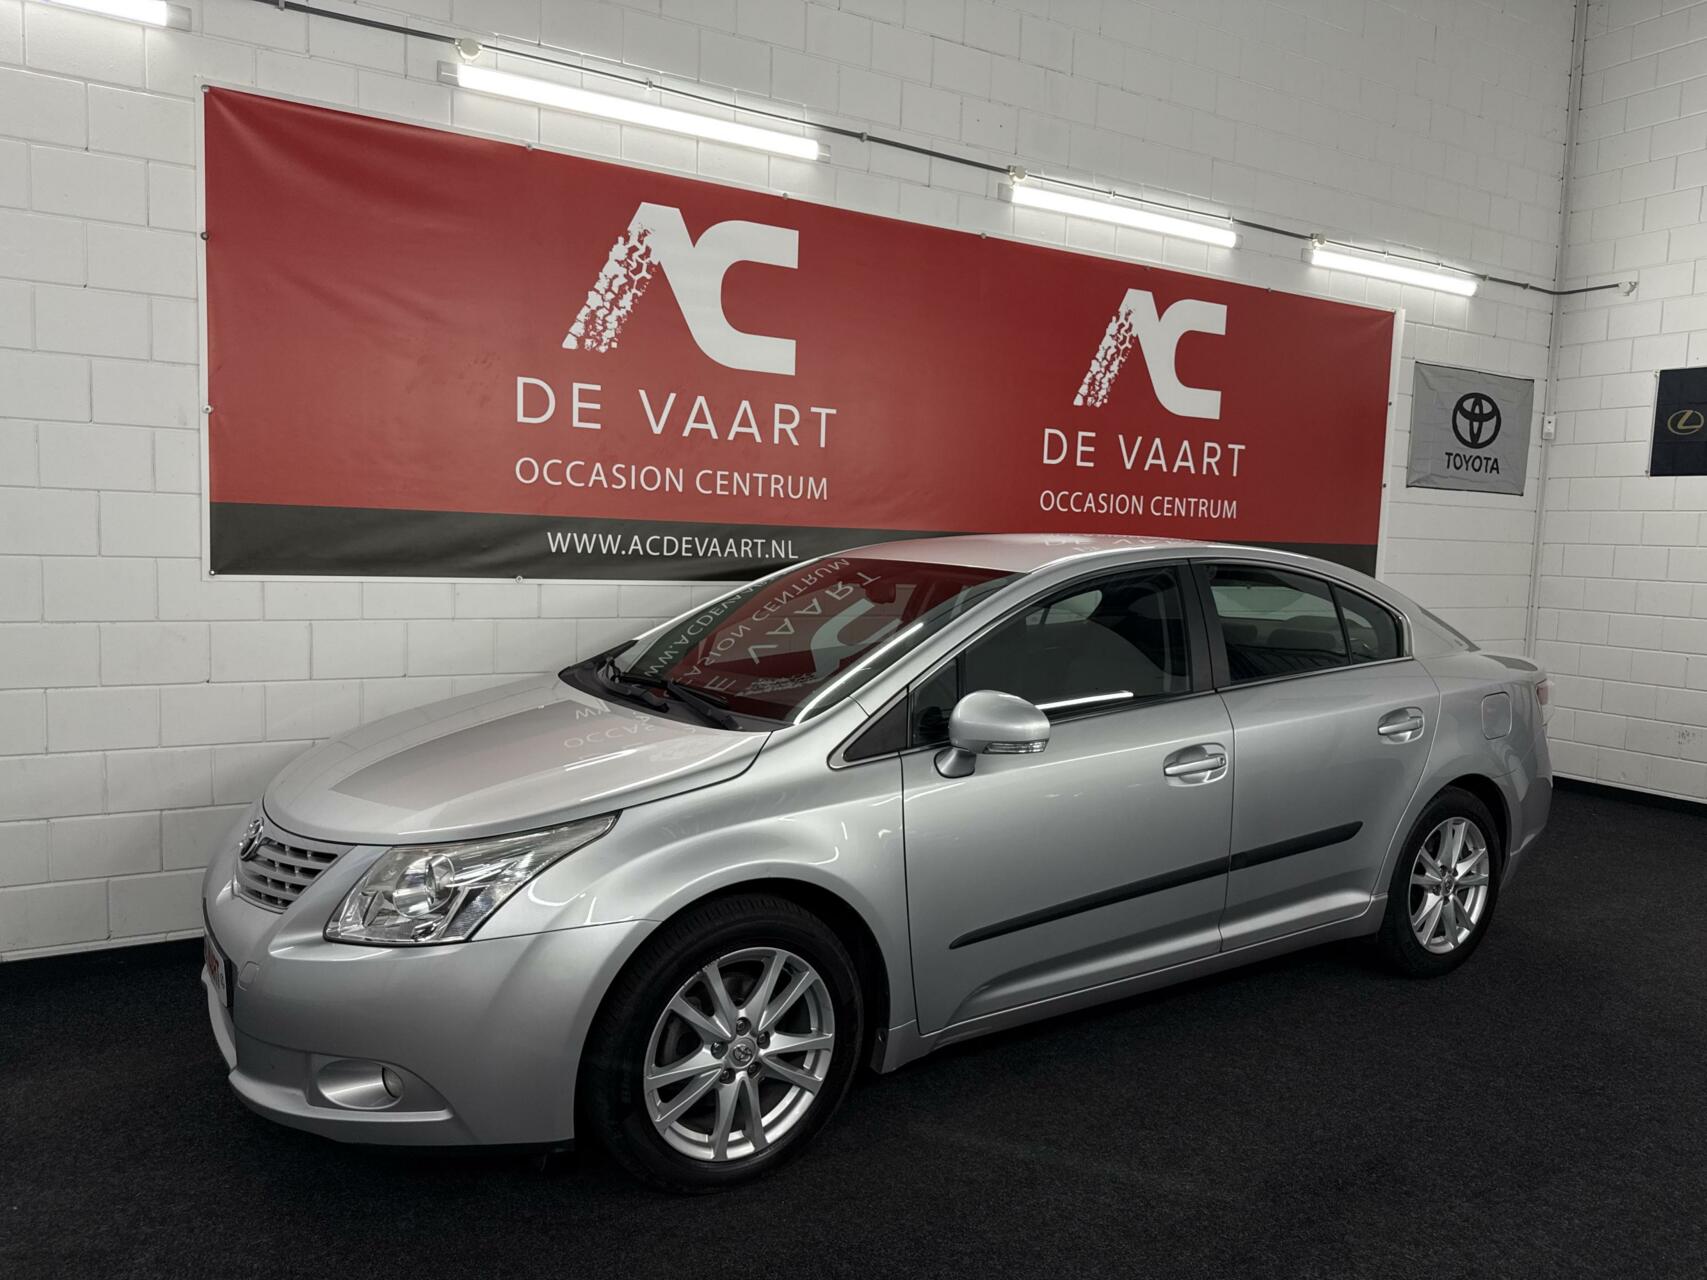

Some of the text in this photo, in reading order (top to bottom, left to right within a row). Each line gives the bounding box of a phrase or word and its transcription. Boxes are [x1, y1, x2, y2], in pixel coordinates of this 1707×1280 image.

[562, 201, 799, 376] AC
[1073, 288, 1228, 420] AC
[517, 377, 836, 447] DE VAART
[1043, 429, 1245, 476] DE VAART
[1445, 452, 1499, 474] TOYOTA
[516, 457, 826, 499] OCCASION CENTRUM
[1040, 490, 1236, 518] OCCASION CENTRUM
[547, 532, 799, 559] WWW.ACDEVAART.NL
